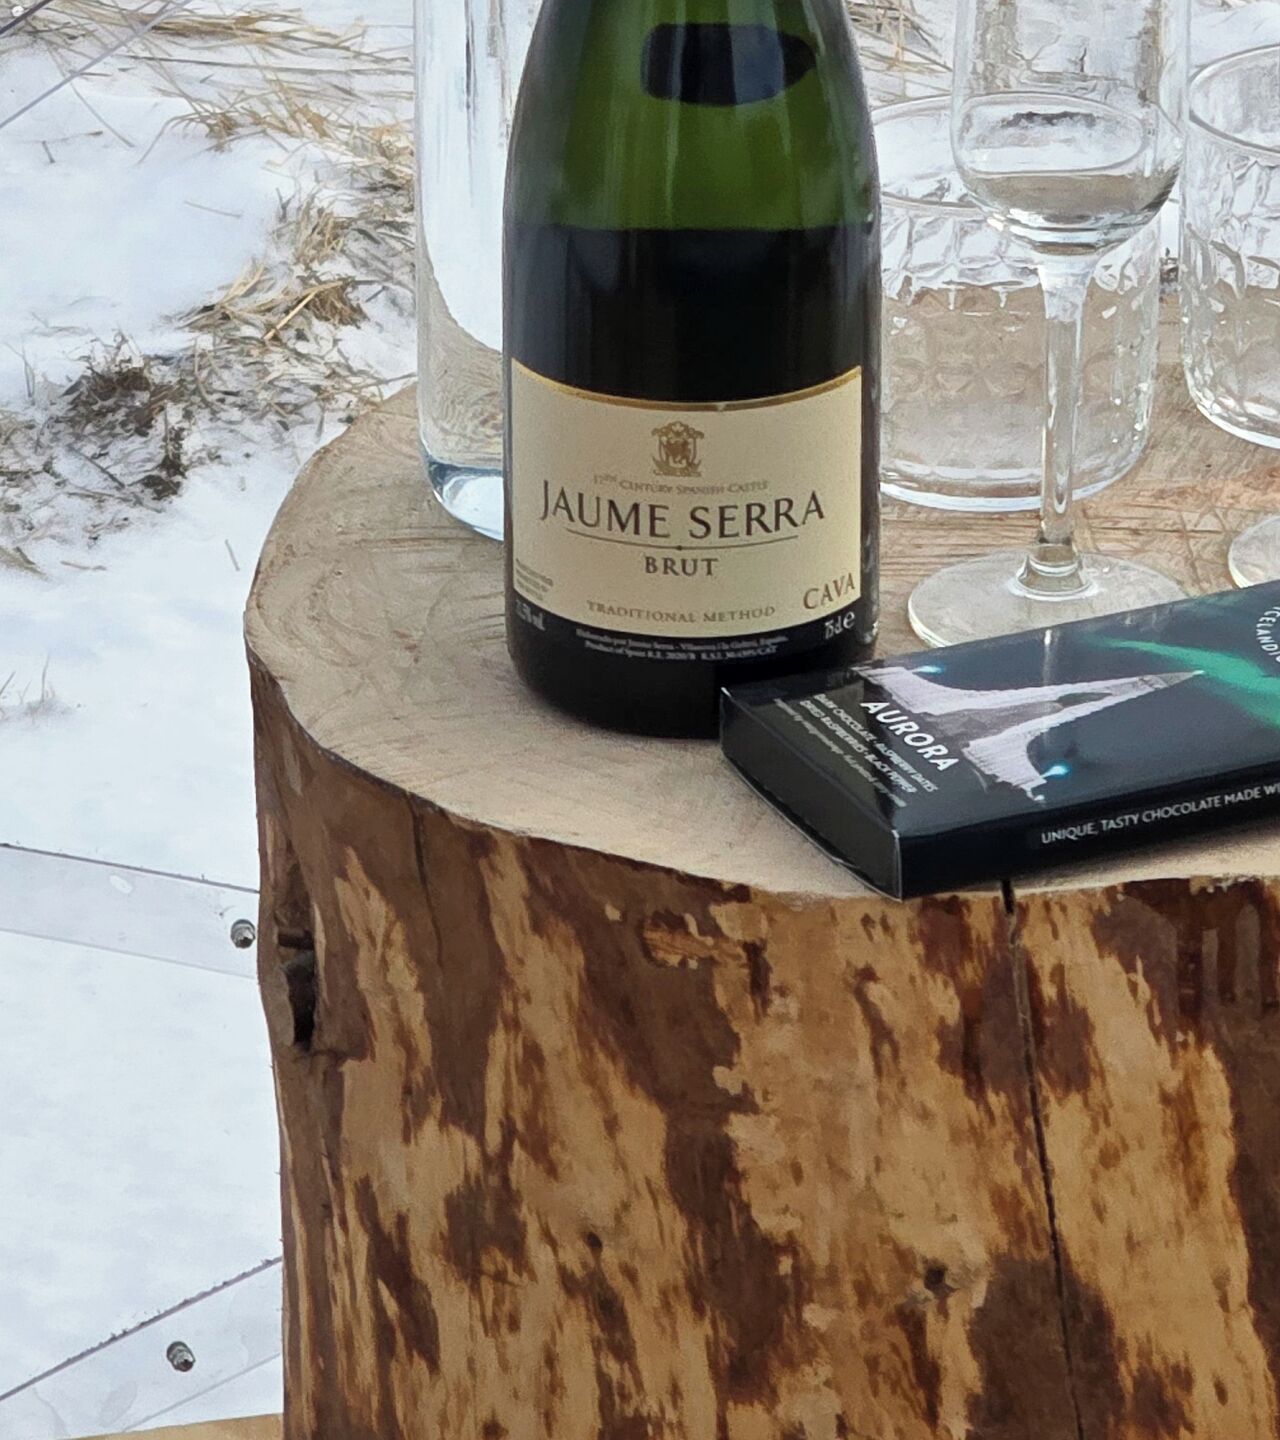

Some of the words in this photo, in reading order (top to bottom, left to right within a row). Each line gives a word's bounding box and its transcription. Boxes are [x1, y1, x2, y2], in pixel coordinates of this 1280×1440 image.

[540, 479, 671, 539] JAUME
[689, 490, 825, 539] SERRA
[644, 556, 719, 577] BRUT
[586, 600, 696, 623] TRADITIONAL
[702, 606, 776, 623] METHOD
[803, 572, 855, 610] CAVA
[860, 702, 959, 771] AURORA
[1100, 813, 1140, 831] TASTY
[1141, 795, 1221, 823] CHOCOLATE
[1224, 786, 1261, 805] MADE
